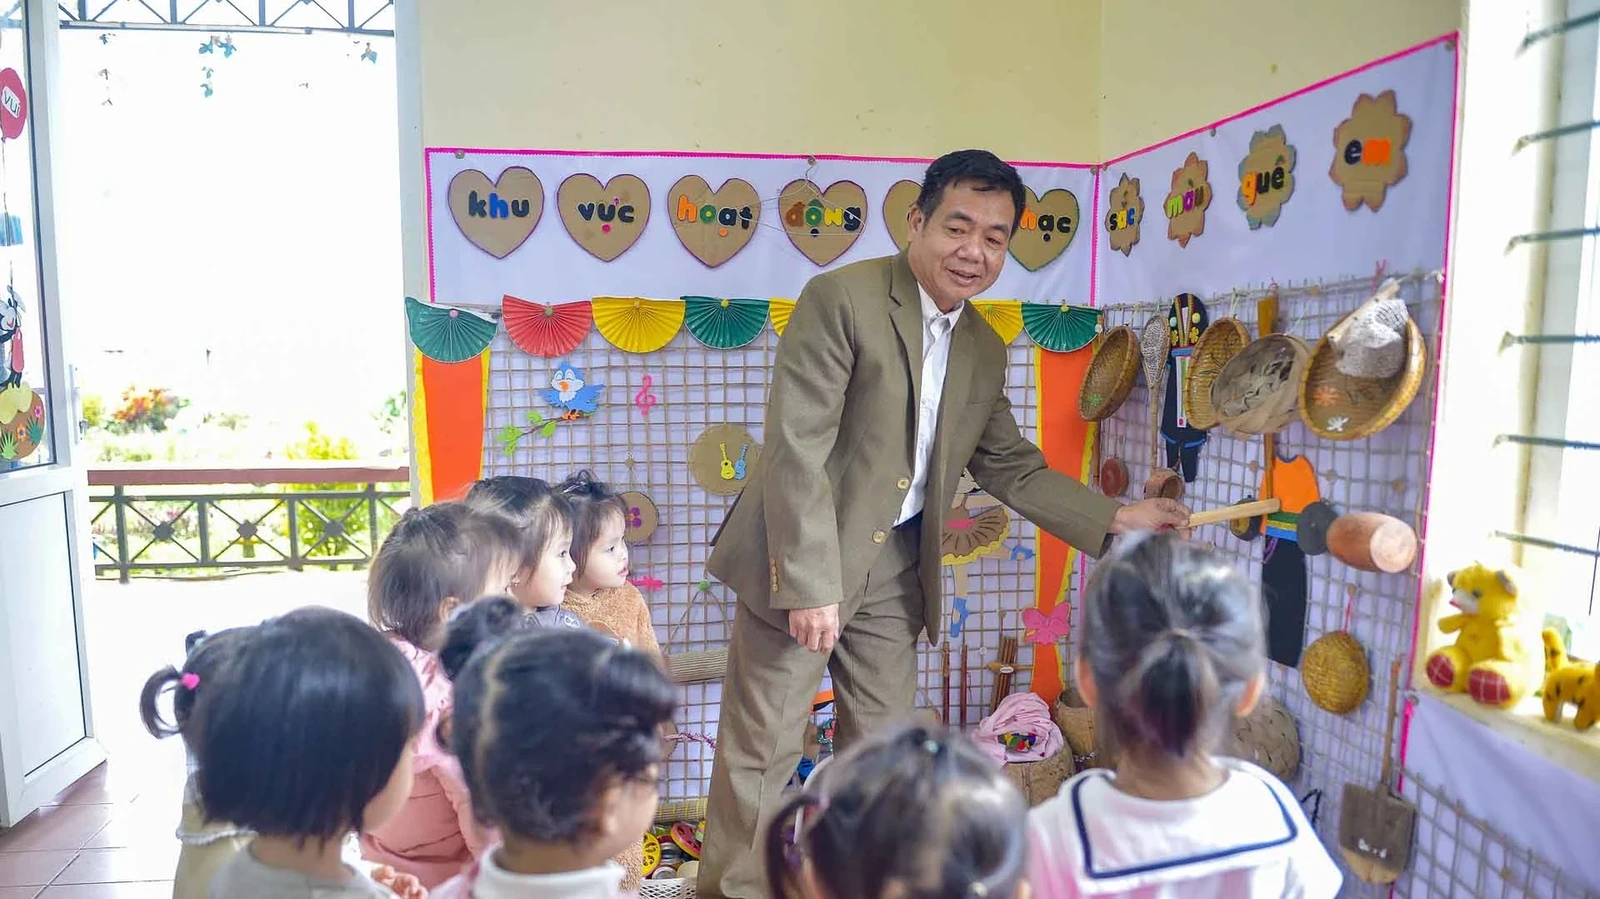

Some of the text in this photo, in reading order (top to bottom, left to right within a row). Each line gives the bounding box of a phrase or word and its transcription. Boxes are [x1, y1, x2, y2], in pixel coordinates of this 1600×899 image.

[4, 90, 21, 117] vui
[1241, 154, 1285, 206] quê
[1344, 136, 1392, 167] em
[468, 190, 530, 218] khu
[577, 196, 635, 233] vực
[677, 194, 753, 237] hoạt
[1020, 206, 1072, 242] hạc
